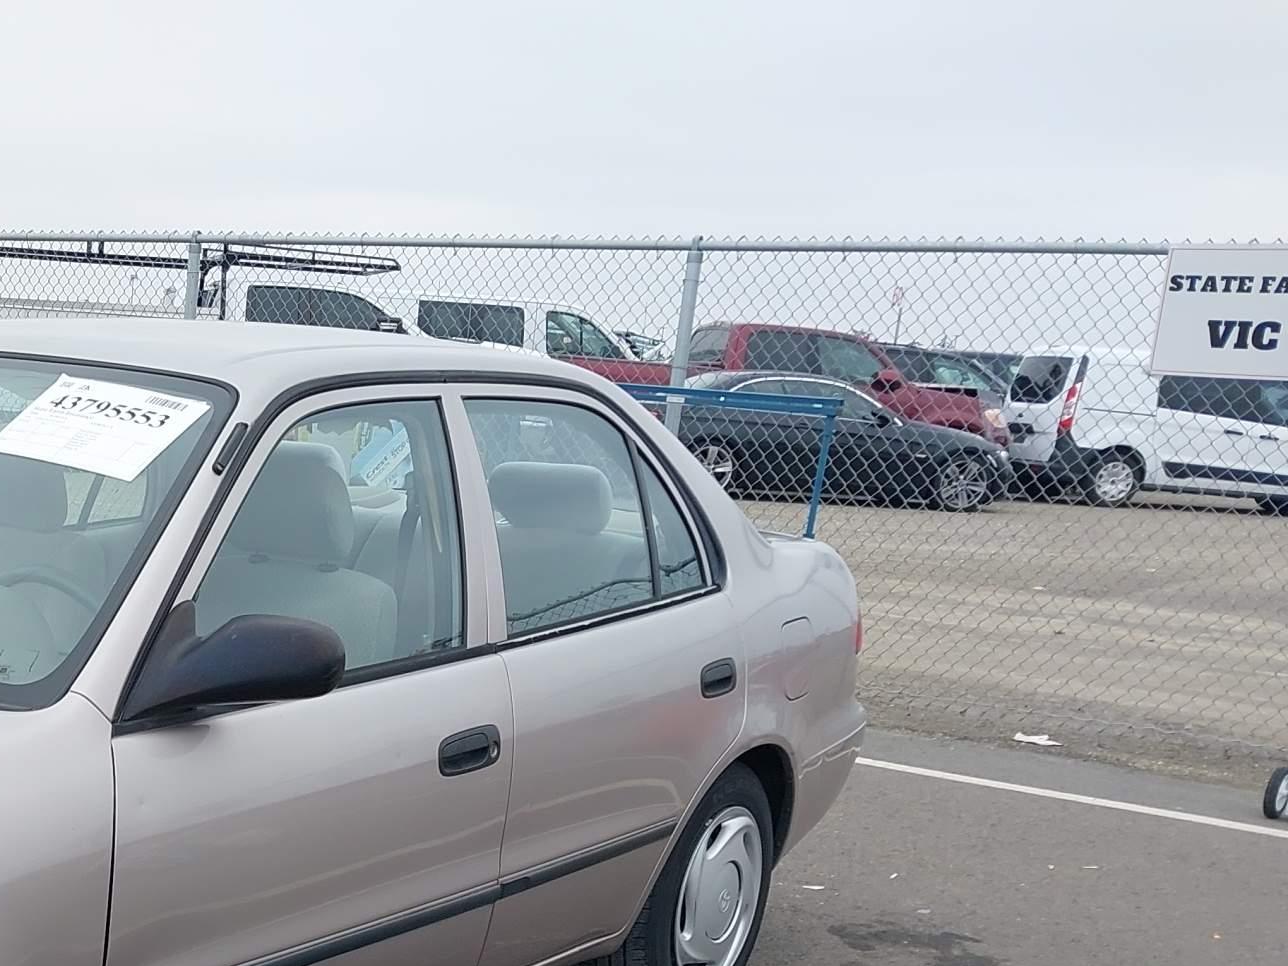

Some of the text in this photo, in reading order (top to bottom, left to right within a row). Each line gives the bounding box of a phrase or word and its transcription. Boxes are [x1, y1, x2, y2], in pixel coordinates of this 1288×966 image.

[1168, 274, 1288, 294] STATE FA
[1207, 319, 1282, 351] VIC
[49, 394, 171, 429] 43795553
